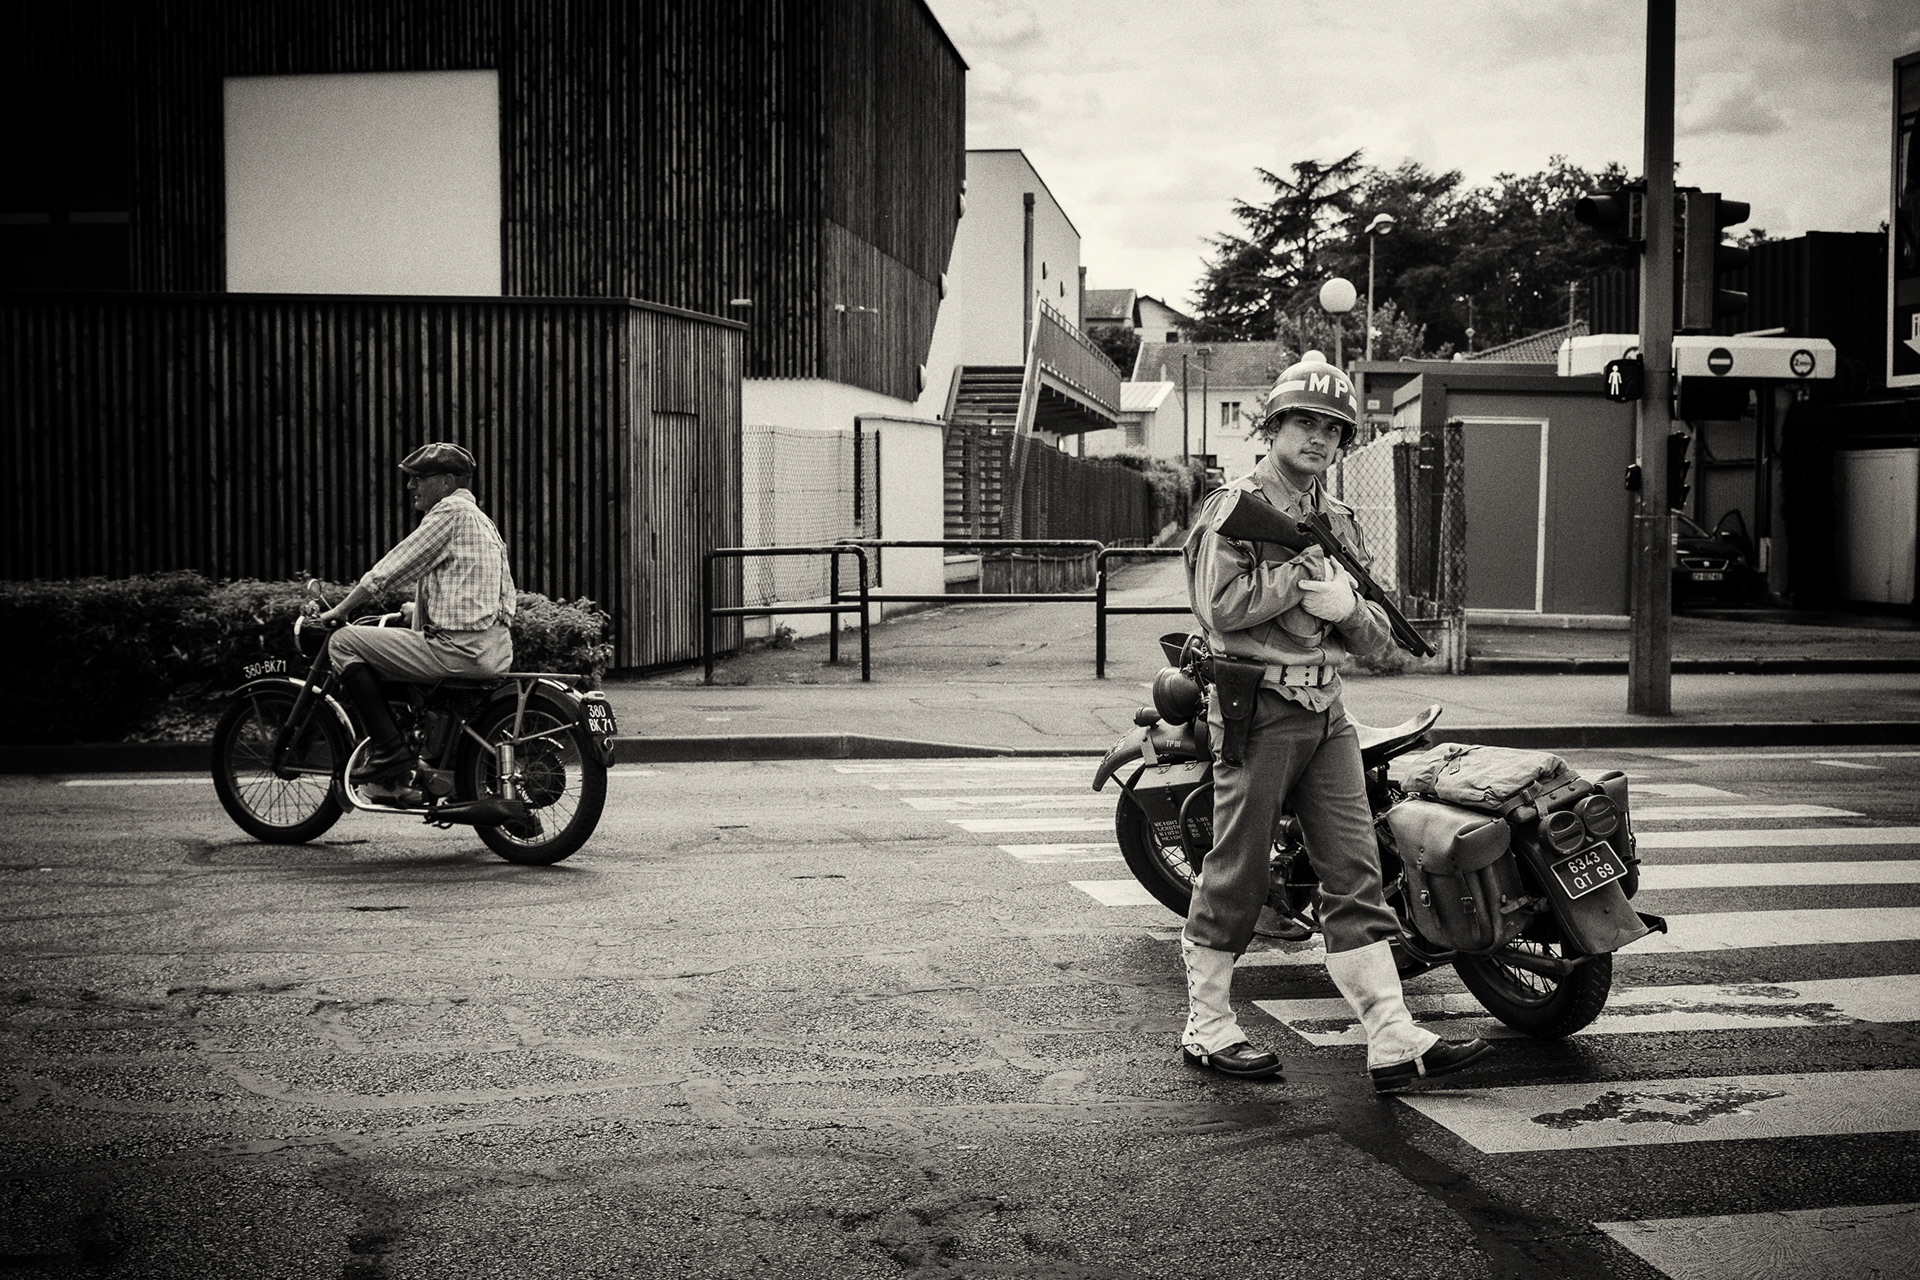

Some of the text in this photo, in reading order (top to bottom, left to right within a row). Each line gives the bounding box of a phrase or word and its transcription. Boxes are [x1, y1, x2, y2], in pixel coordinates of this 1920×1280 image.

[587, 704, 606, 718] 380
[588, 718, 614, 732] BK 71
[1567, 851, 1601, 874] 6343
[1574, 862, 1615, 890] QT 69
